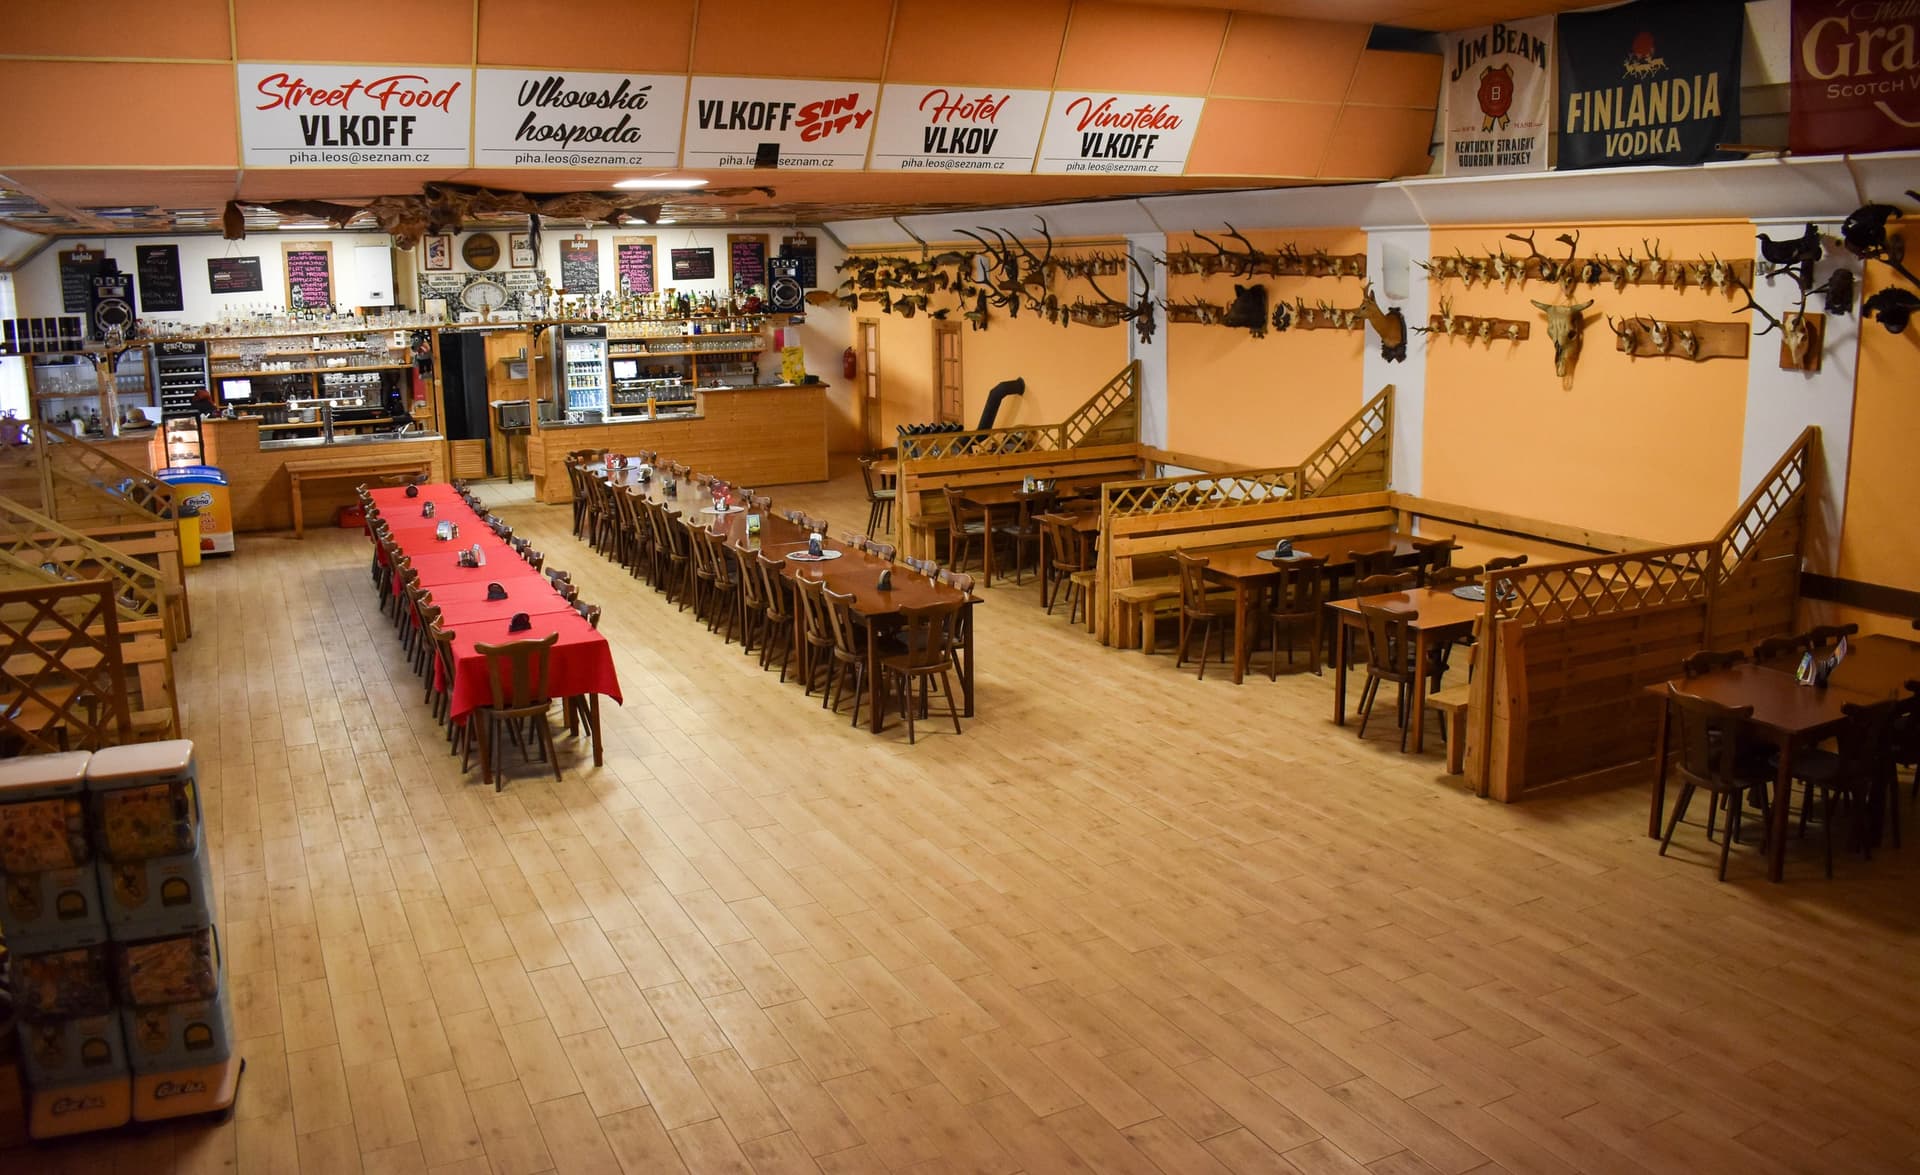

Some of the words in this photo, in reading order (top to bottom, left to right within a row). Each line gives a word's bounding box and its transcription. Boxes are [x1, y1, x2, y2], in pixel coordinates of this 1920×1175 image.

[1452, 34, 1488, 82] JIM
[1493, 23, 1546, 71] BEAM
[256, 72, 363, 112] Street
[363, 75, 461, 114] Food
[517, 76, 653, 110] Vlkovská
[1566, 72, 1721, 134] FINLANDIA
[1826, 79, 1904, 99] SCOTCH
[699, 99, 796, 131] VLKOFF
[795, 93, 859, 127] SIN
[919, 89, 1010, 124] Hotel
[1065, 97, 1183, 132] Vinotéka
[299, 115, 417, 147] VLKOFF
[515, 111, 642, 149] hospoda
[800, 109, 873, 143] CITY
[924, 126, 999, 154] VLKOV
[289, 151, 431, 165] piha.leos@seznam.cz
[1080, 132, 1160, 159] VLKOFF
[1455, 140, 1495, 154] KENTUCKY
[1605, 127, 1681, 158] VODKA
[515, 153, 643, 166] piha.leos@seznam.cz
[719, 155, 834, 168] piha.leseznam.cz
[901, 158, 1005, 170] piha.leos@seznam.cz
[1066, 161, 1159, 173] piha.leos@seznam.cz
[1458, 154, 1494, 168] BOURBON
[1497, 151, 1531, 167] WHISKEY
